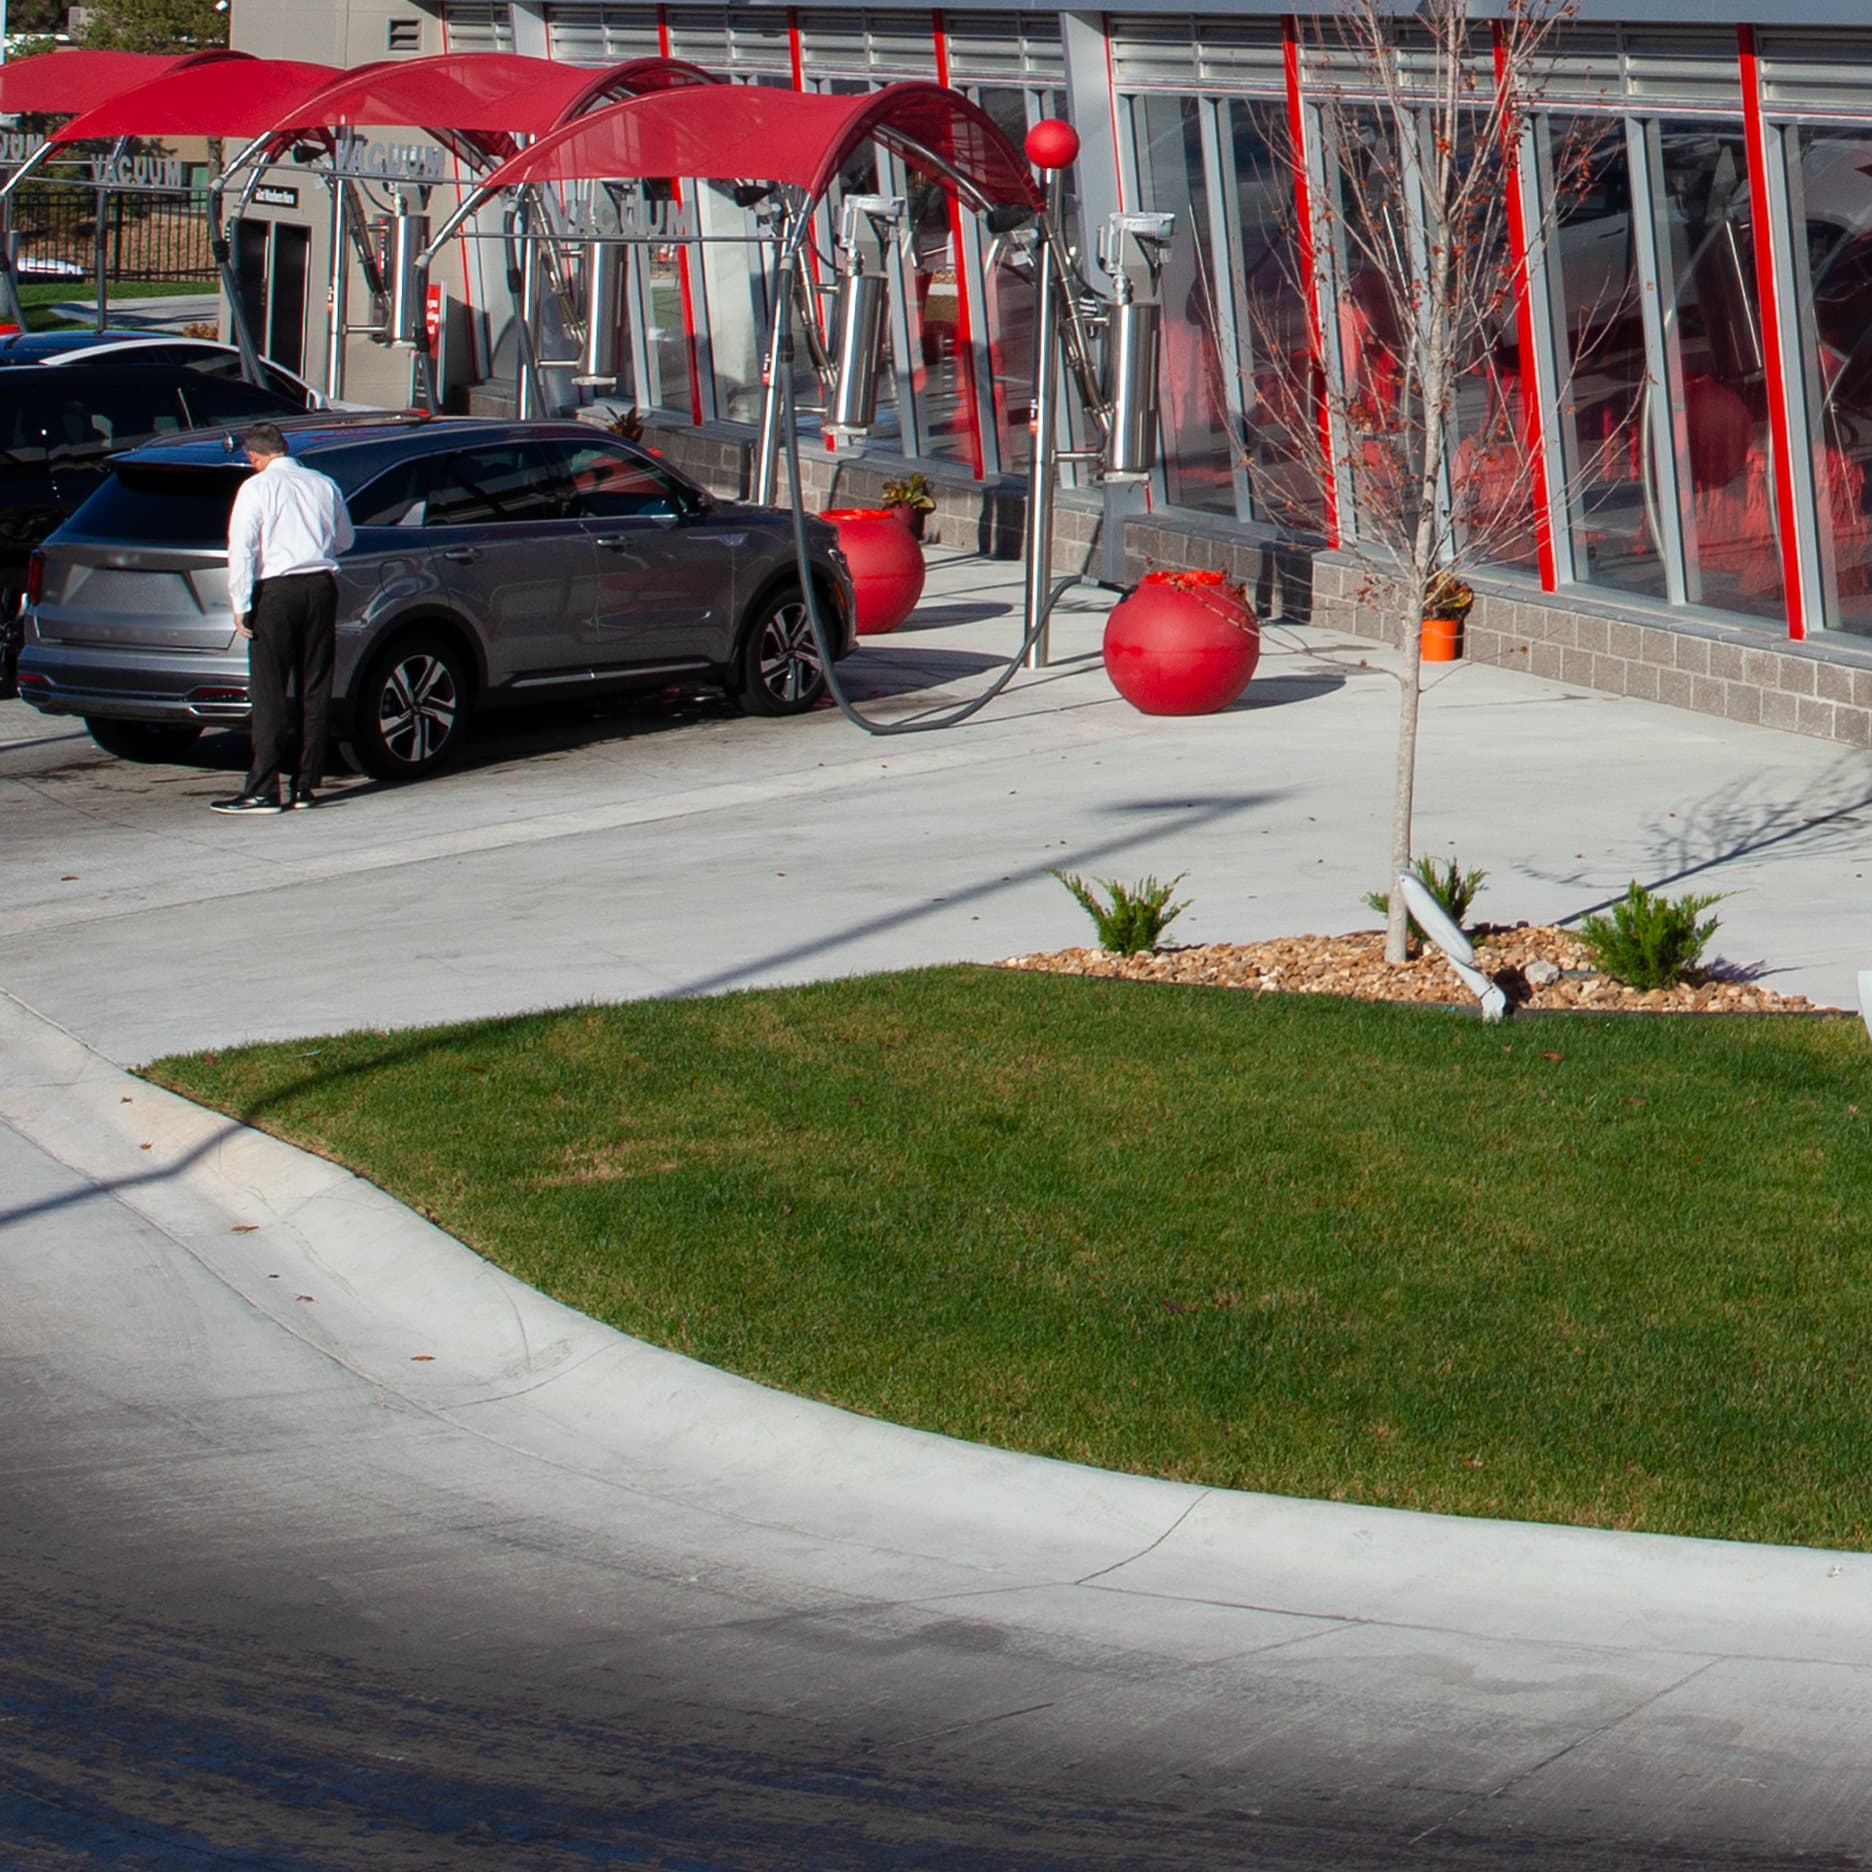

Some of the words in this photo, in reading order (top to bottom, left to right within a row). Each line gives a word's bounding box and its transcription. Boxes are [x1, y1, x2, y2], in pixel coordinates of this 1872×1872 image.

[90, 153, 183, 188] VACUUM
[335, 139, 445, 179] VACUUM
[551, 199, 694, 237] VACUUM
